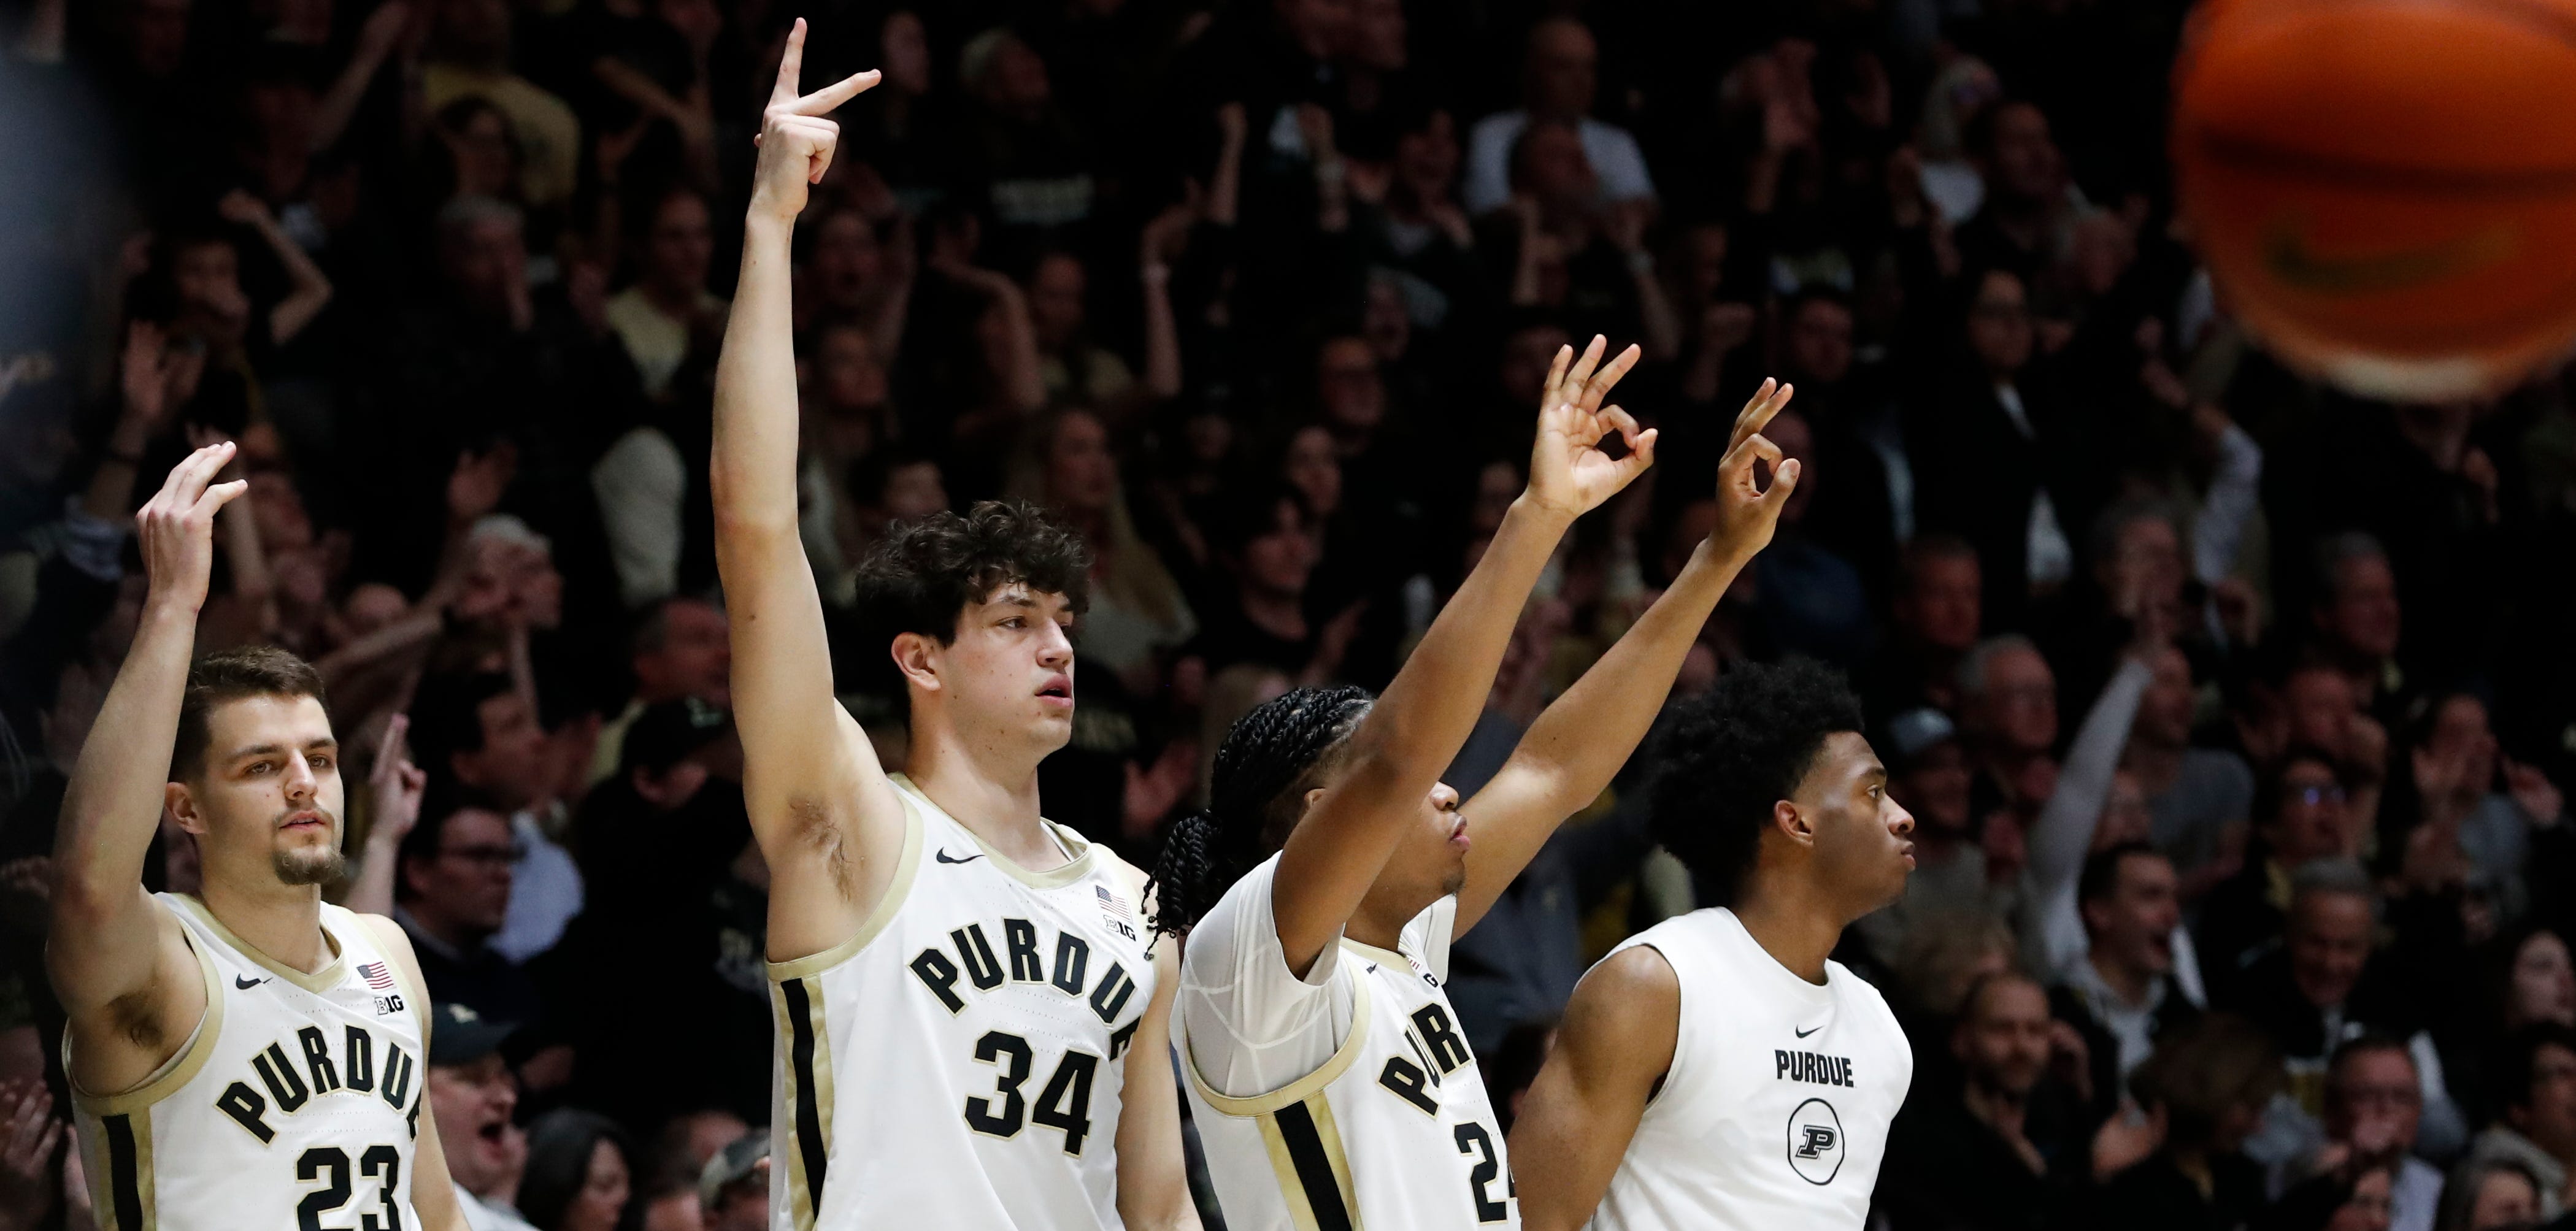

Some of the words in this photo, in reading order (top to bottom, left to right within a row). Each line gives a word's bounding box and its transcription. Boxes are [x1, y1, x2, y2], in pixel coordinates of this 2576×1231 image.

[961, 1029, 1101, 1159] 34
[1775, 1049, 1854, 1087] PURDUE
[1796, 1125, 1837, 1159] P
[294, 1145, 401, 1230] 23
